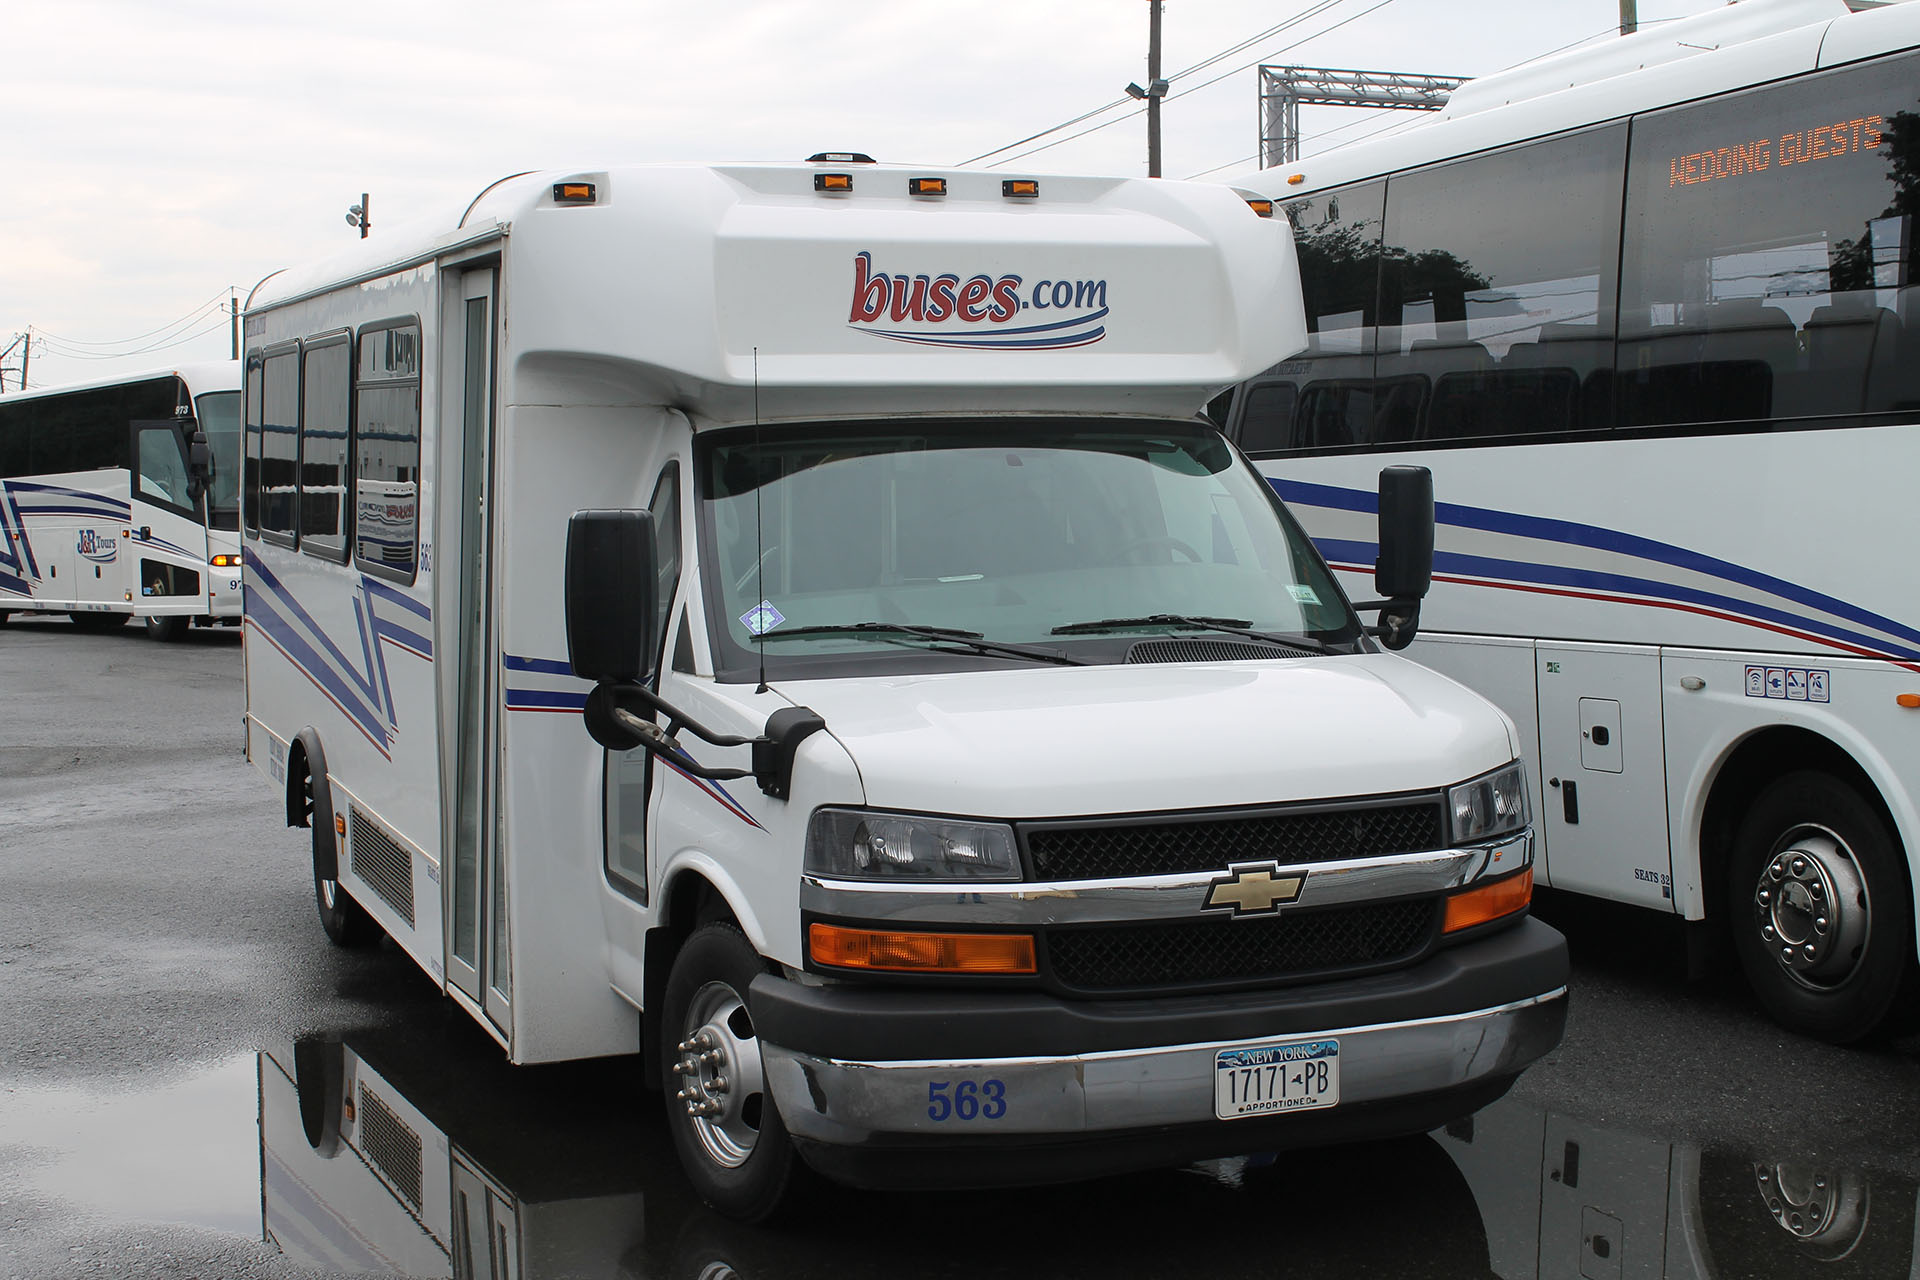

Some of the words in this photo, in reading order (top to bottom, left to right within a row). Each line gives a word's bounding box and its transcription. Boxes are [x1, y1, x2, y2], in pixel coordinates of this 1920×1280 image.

[1669, 138, 1771, 188] WEDDING
[1778, 114, 1883, 167] GUESTS
[848, 251, 1107, 323] buses.com
[174, 404, 189, 415] 973
[77, 529, 97, 554] J&R
[96, 535, 117, 549] Tours
[1634, 868, 1659, 884] SEATS
[1660, 873, 1670, 886] 32
[1246, 1049, 1275, 1065] NEW
[1278, 1046, 1310, 1061] YORK
[1228, 1064, 1286, 1104] 17171
[1305, 1060, 1329, 1095] PB
[927, 1079, 1007, 1122] 563
[1245, 1096, 1312, 1112] APPORTIONED
